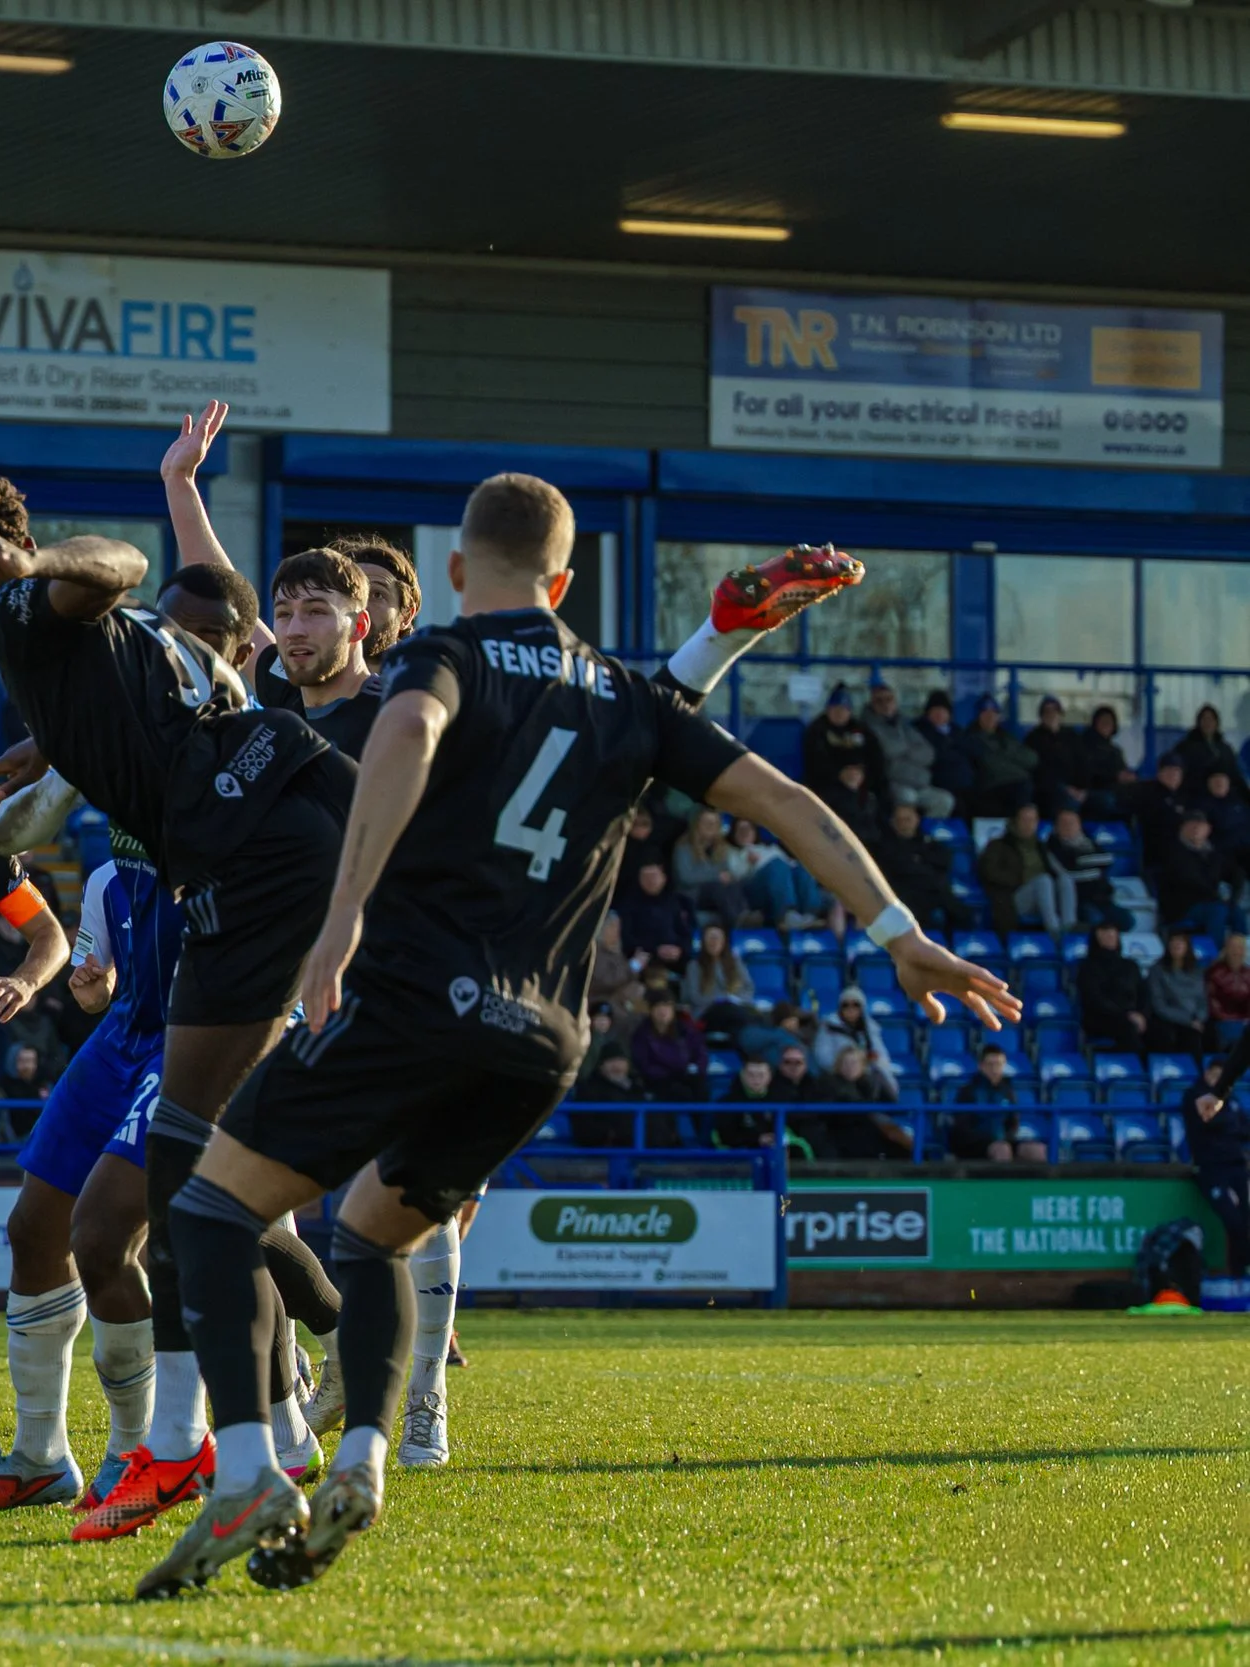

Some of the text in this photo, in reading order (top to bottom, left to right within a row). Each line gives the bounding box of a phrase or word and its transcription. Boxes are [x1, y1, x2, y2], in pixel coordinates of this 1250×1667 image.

[733, 305, 839, 371] TNR
[897, 315, 1015, 342] ROBINSON
[1020, 321, 1062, 346] LTD
[25, 362, 41, 386] &
[46, 363, 84, 392] Dry
[91, 366, 144, 389] Riser
[150, 368, 258, 396] Specialists
[732, 390, 767, 417] For
[773, 392, 804, 419] all
[809, 400, 861, 424] your
[867, 398, 979, 426] electrical
[233, 727, 277, 775] FOOTBALL
[244, 744, 276, 782] GROUP
[493, 726, 579, 883] 4
[555, 1205, 673, 1238] Pinnacle
[1032, 1195, 1124, 1223] HERE FOR
[970, 1227, 1007, 1255] THE
[1013, 1227, 1107, 1254] NATIONAL
